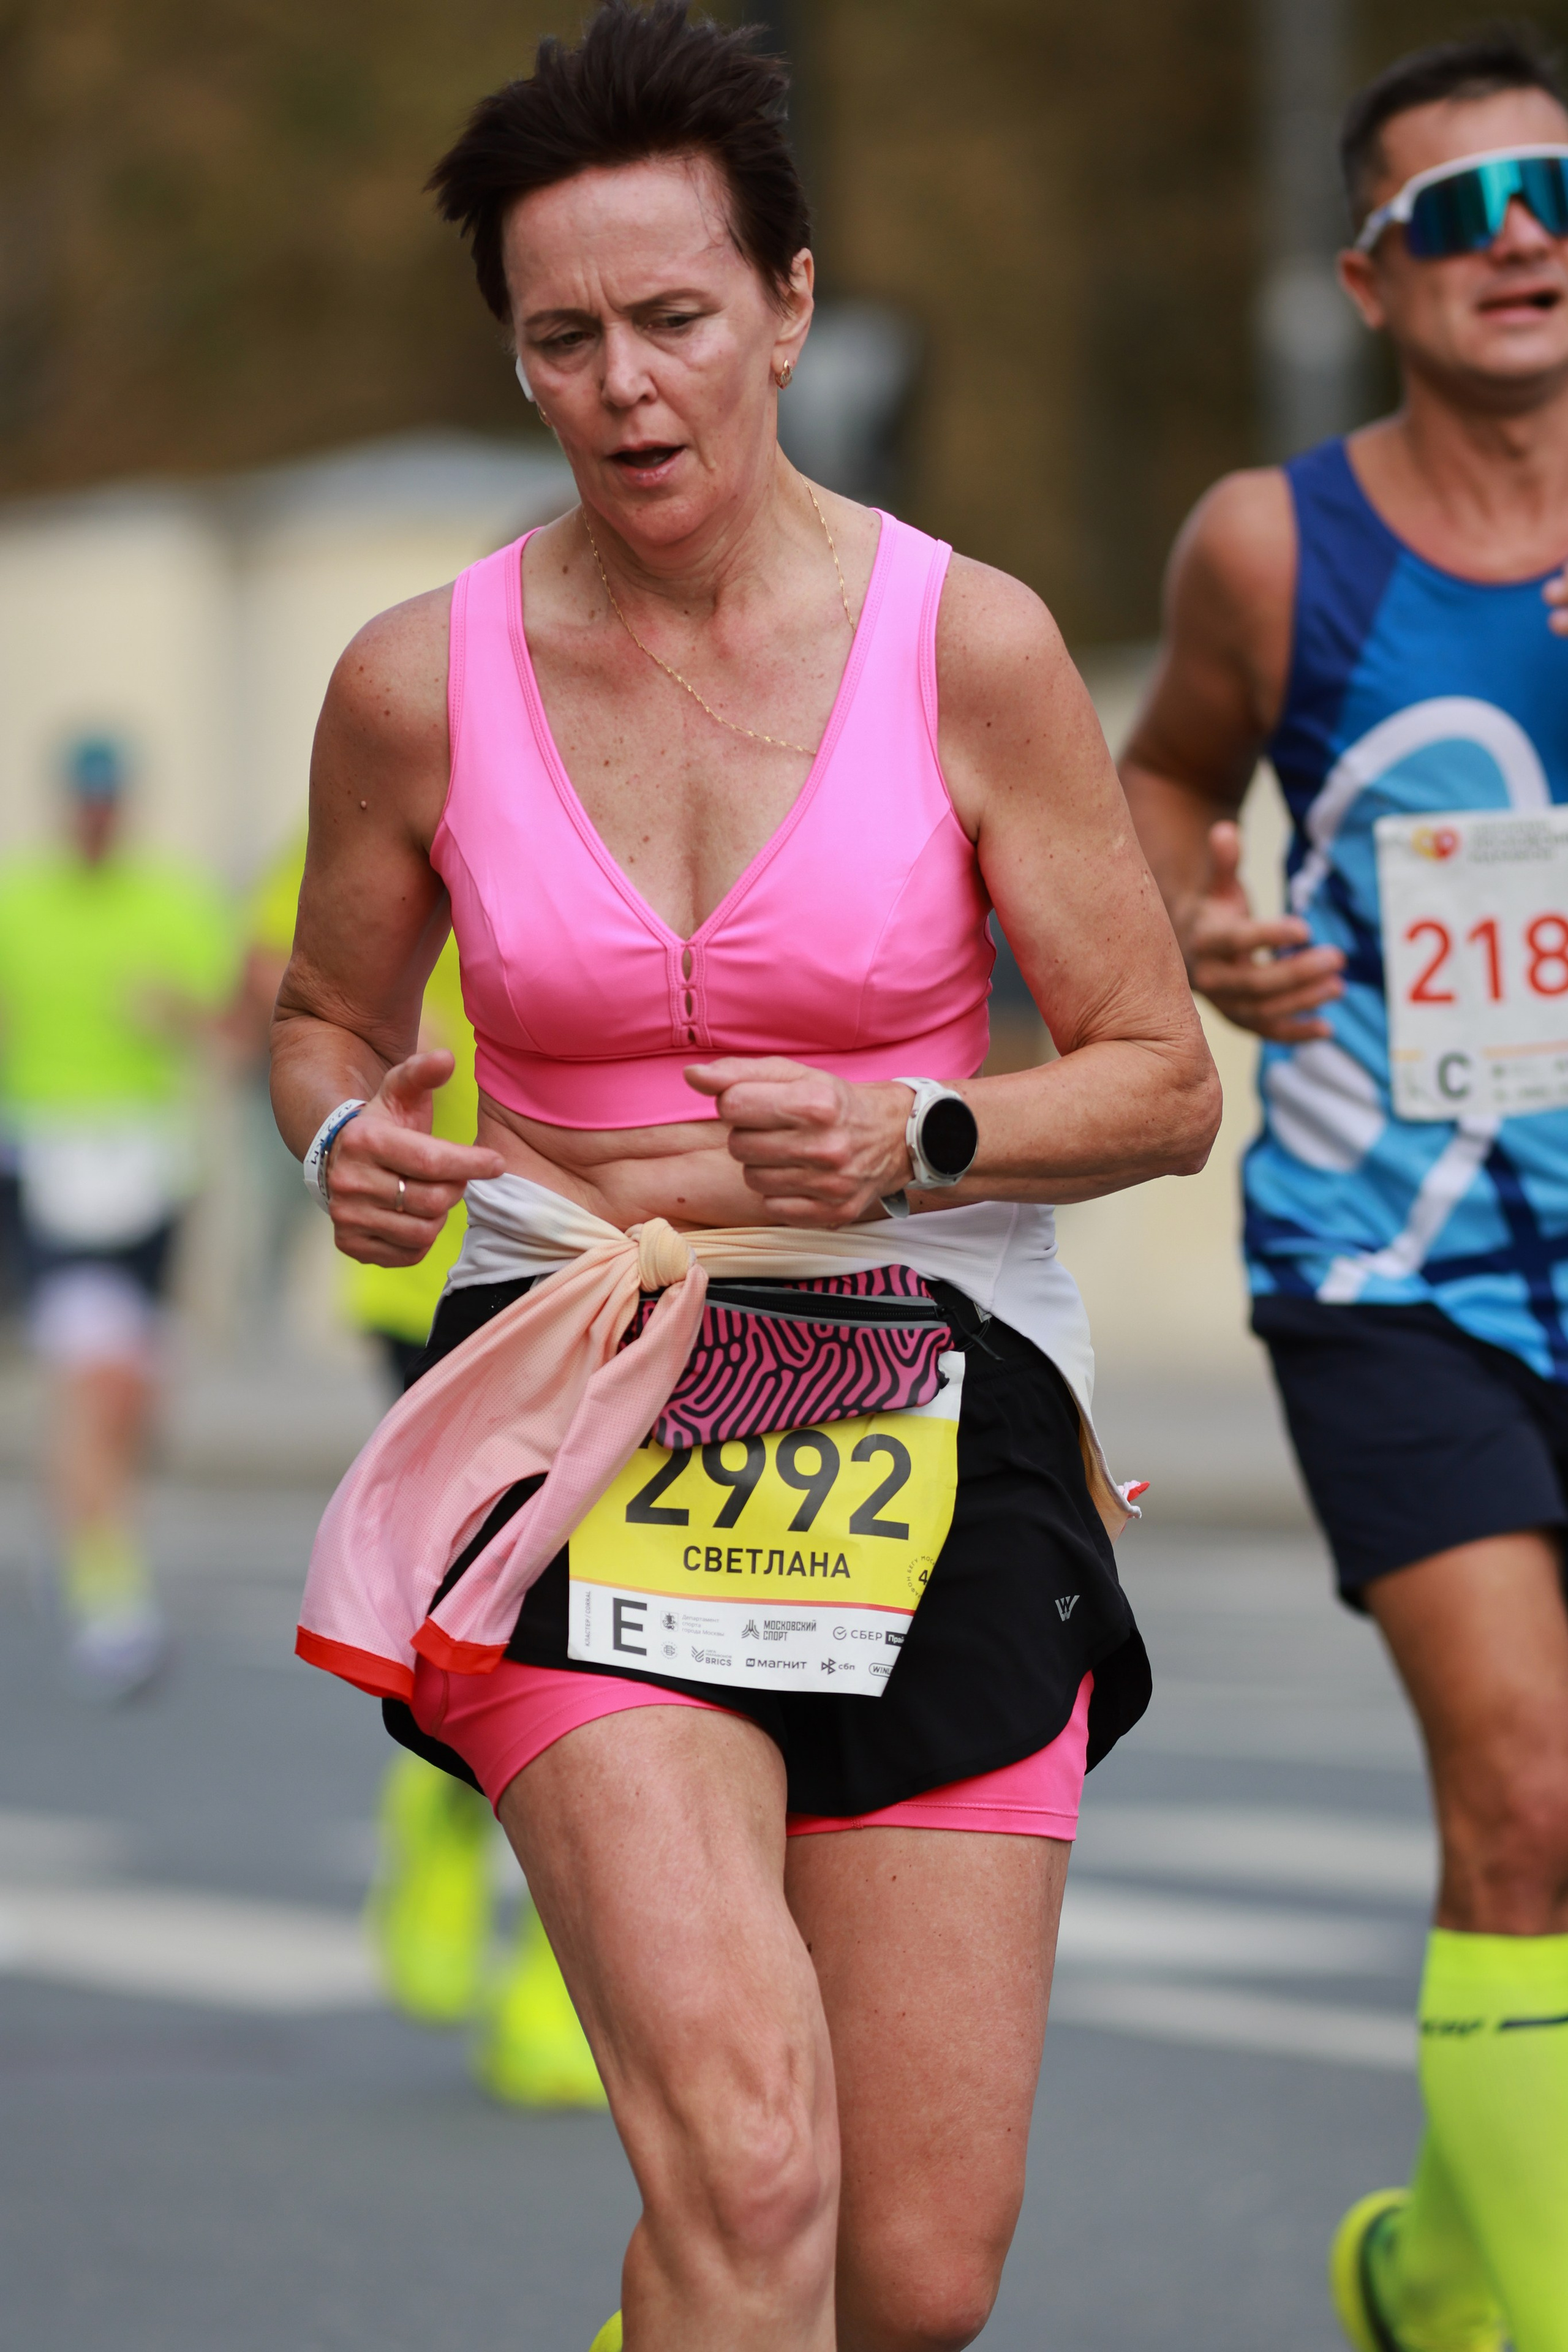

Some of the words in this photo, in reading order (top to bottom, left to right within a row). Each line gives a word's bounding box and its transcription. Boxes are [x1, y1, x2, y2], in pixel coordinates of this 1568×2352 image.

[1406, 913, 1568, 1005] 218
[625, 1428, 912, 1540] 2992
[683, 1545, 851, 1578] СВЕТЛАНА
[918, 1569, 929, 1586] 4
[763, 1619, 816, 1632] МОСКОВСКИЙ
[763, 1630, 788, 1642] СПОРТ
[851, 1629, 883, 1641] СБЕР
[705, 1657, 732, 1667] BRICS
